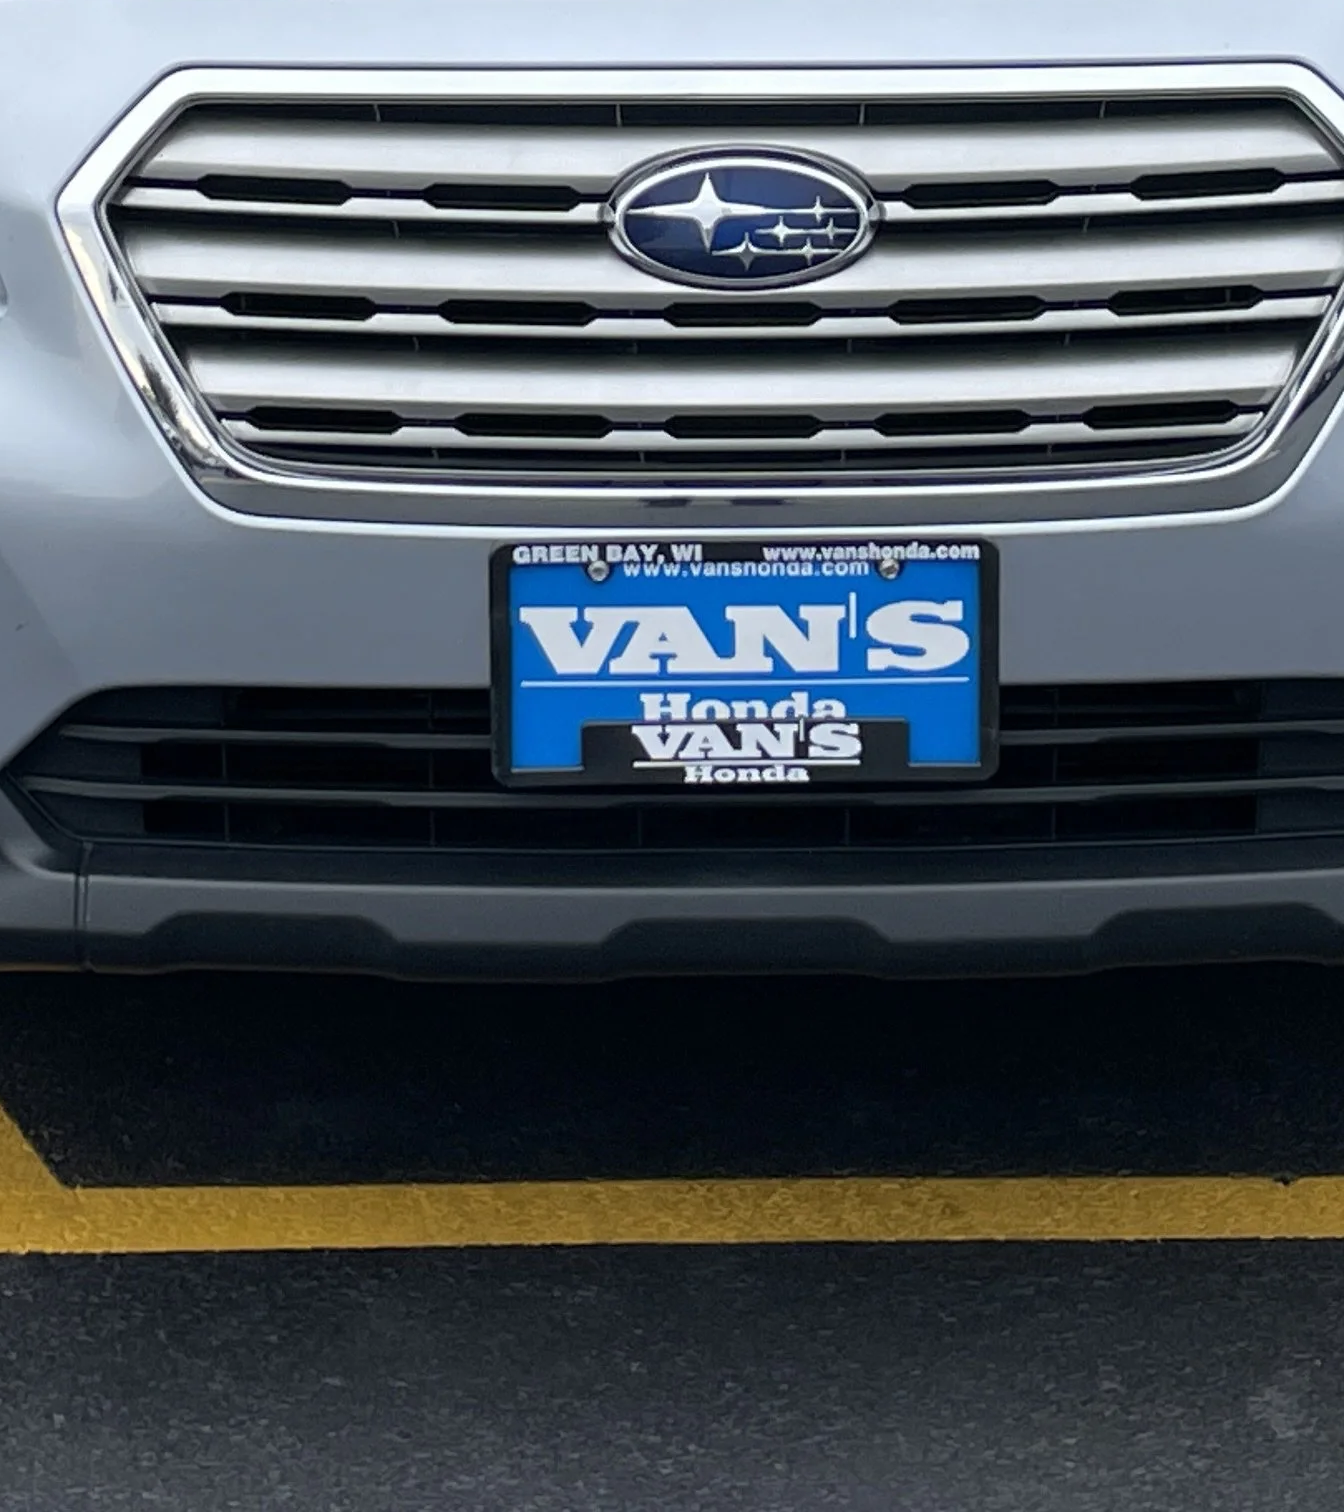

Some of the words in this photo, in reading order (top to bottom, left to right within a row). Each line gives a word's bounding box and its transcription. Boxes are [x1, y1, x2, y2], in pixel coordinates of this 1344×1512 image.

[512, 544, 600, 565] GREEN
[605, 544, 666, 565] BAY,
[670, 543, 704, 562] WI
[761, 541, 982, 562] www.vanshonda.com
[518, 591, 971, 676] VAN'S
[639, 691, 847, 721] Honda
[631, 717, 863, 760] VAN'S
[683, 764, 811, 784] Honda
